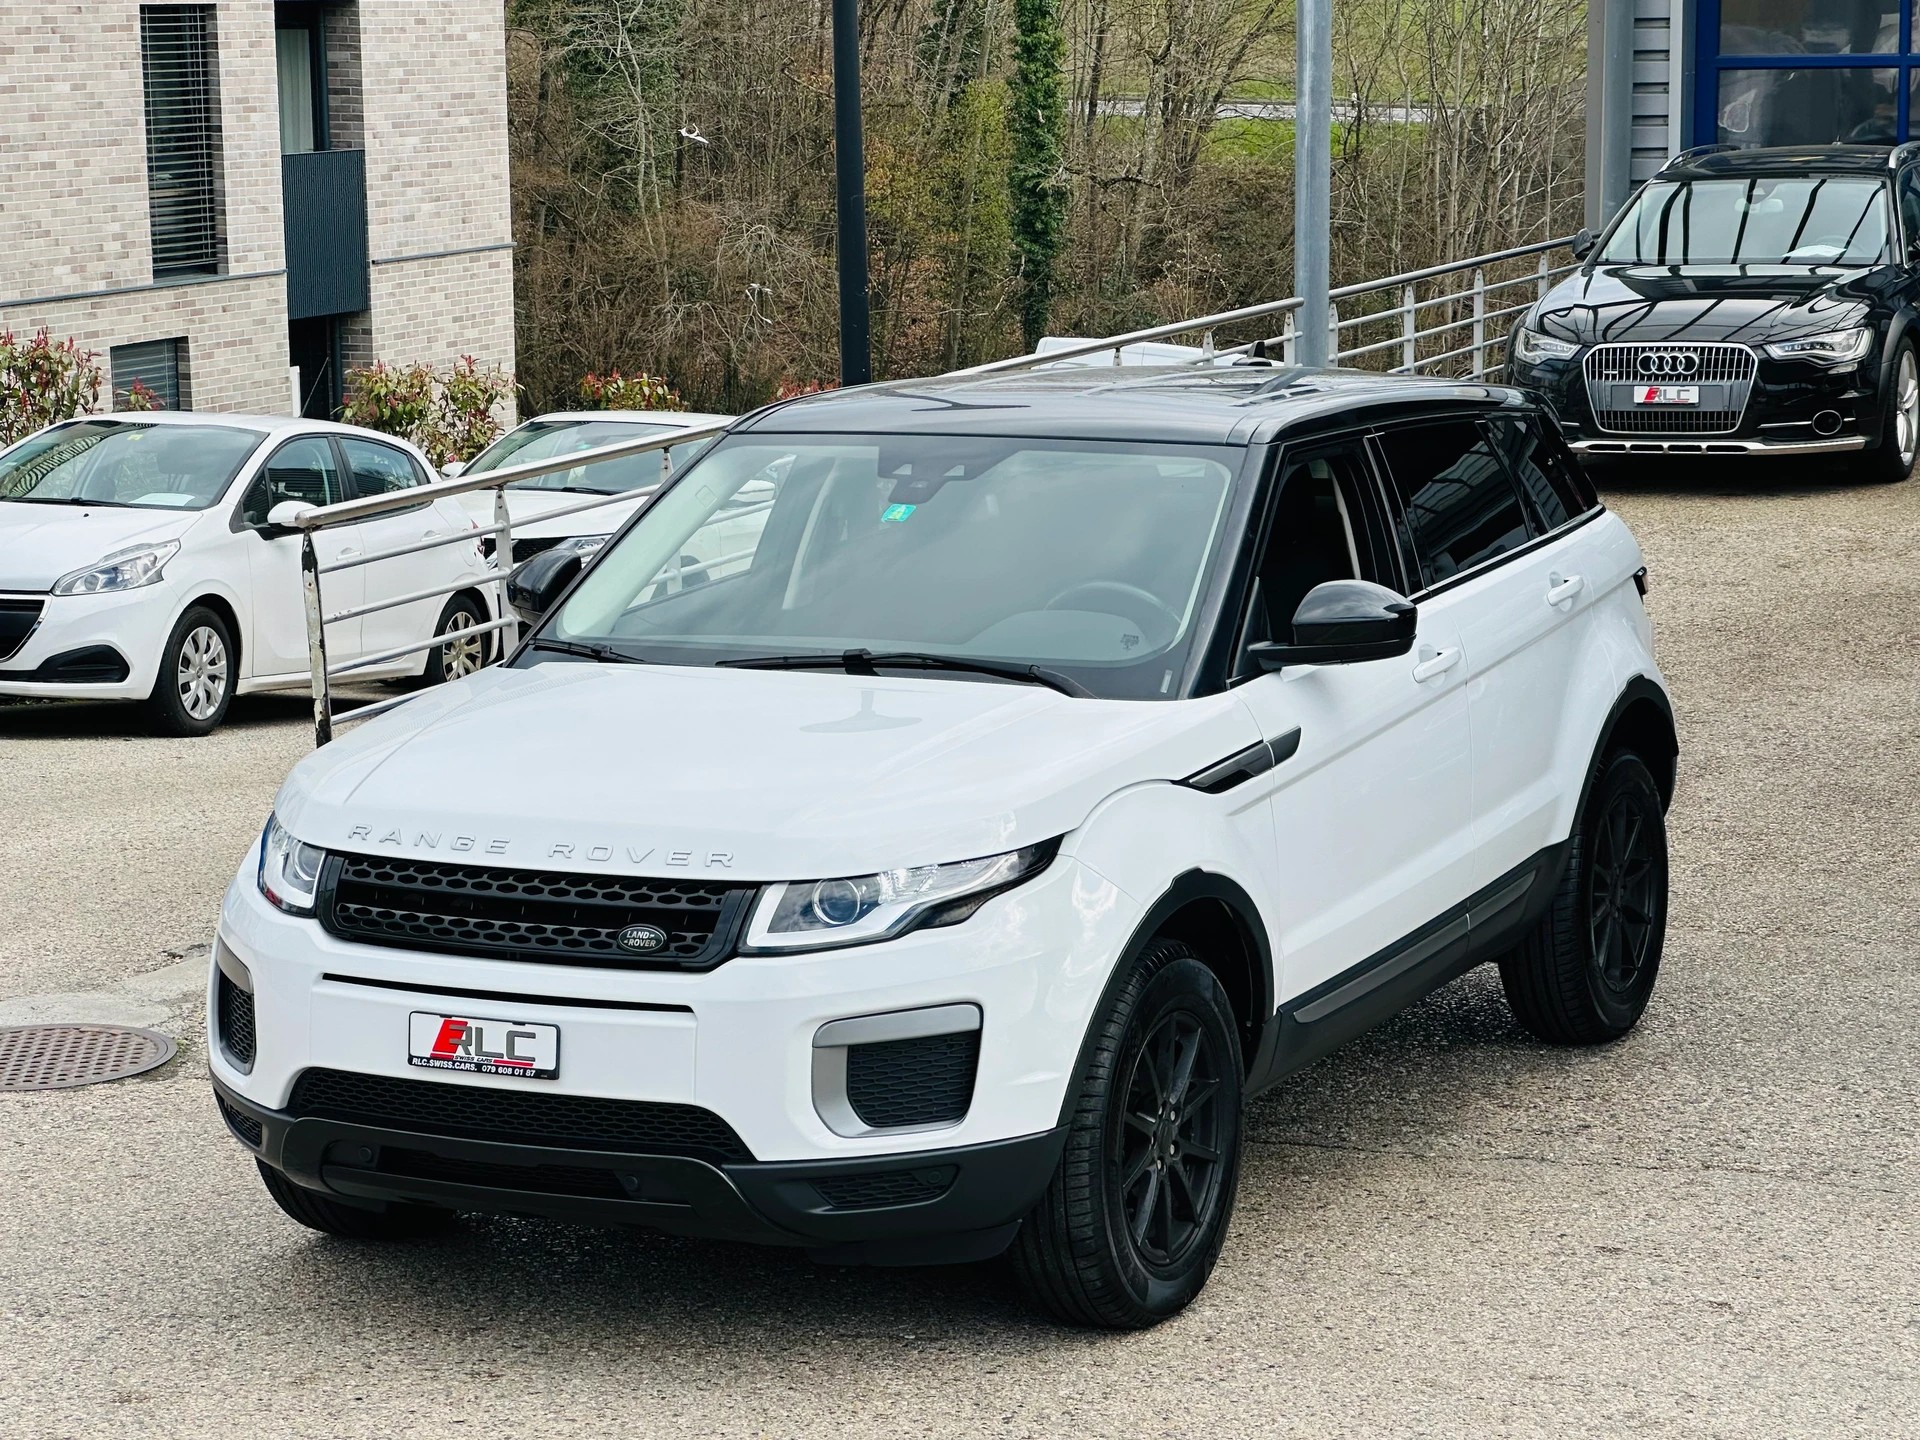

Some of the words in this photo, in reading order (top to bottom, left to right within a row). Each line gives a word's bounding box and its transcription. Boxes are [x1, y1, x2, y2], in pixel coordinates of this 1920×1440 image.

[1645, 387, 1691, 401] RLC
[347, 823, 511, 855] RANGE
[547, 840, 735, 869] ROVER
[628, 938, 657, 947] ROVER
[439, 1021, 537, 1062] RLC
[412, 1057, 478, 1071] RLC.SWISS.CARS.
[482, 1065, 497, 1073] 079
[497, 1067, 513, 1075] 608
[514, 1068, 524, 1076] 01
[525, 1069, 536, 1077] 87
